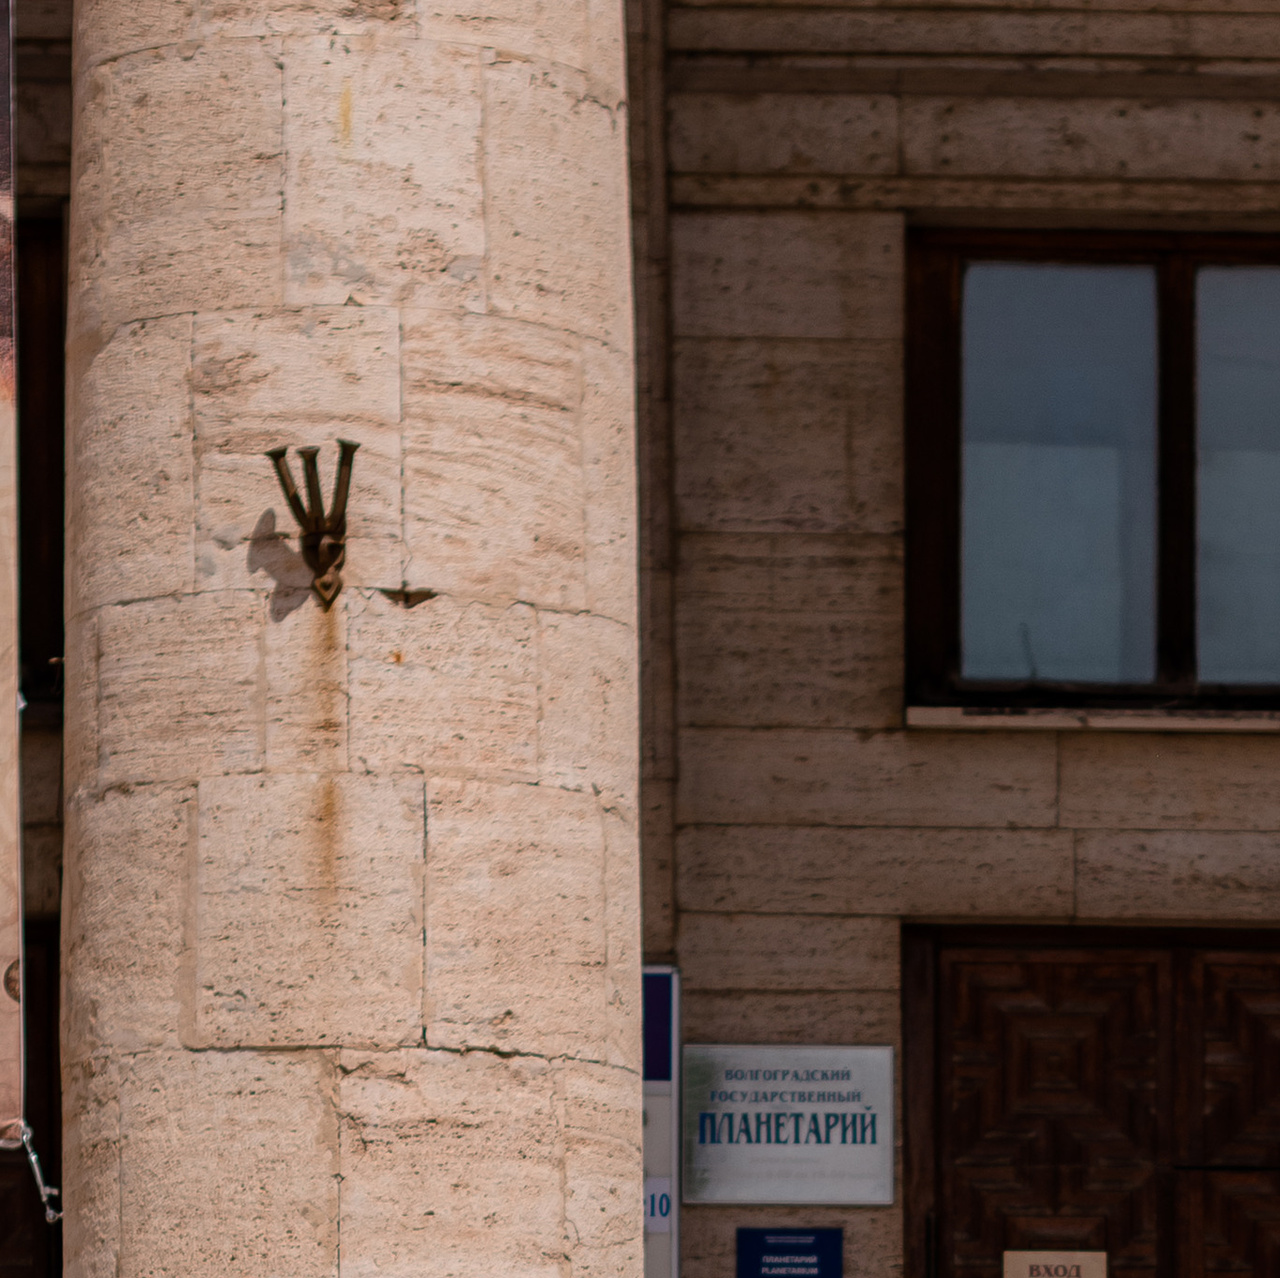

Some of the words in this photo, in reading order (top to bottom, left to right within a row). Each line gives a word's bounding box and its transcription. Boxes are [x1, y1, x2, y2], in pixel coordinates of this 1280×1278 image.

[724, 1066, 852, 1082] ВОЛГОГРАДСКИЙ
[709, 1088, 863, 1103] ГОСУДАРСТВЕННЫЙ
[697, 1105, 878, 1145] ПЛАНЕТАРИЙ
[1028, 1264, 1082, 1278] ВХОД
